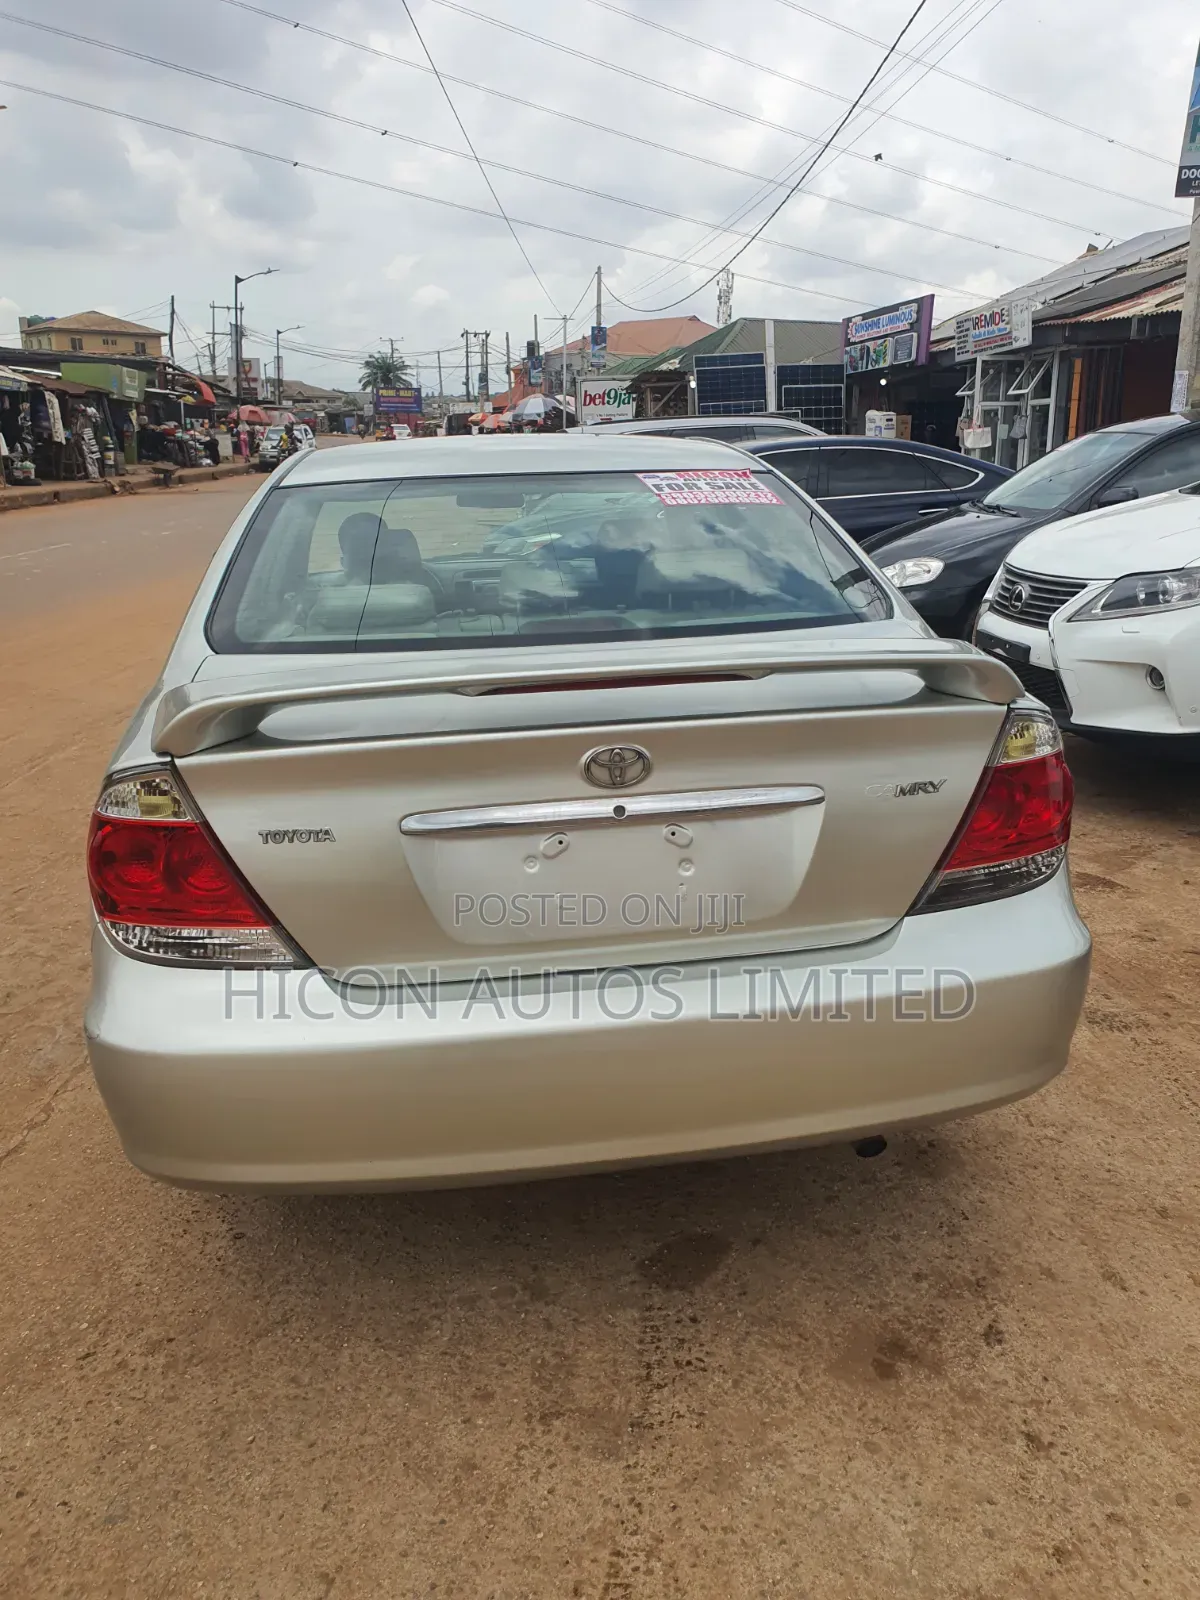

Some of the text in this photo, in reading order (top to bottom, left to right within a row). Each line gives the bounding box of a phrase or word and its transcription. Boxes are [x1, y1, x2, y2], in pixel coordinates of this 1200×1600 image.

[854, 309, 913, 336] SUNSHINE LUMINOUS
[583, 387, 632, 408] bet9ja
[651, 482, 765, 492] FOR SALE
[258, 827, 336, 844] TOYOTA
